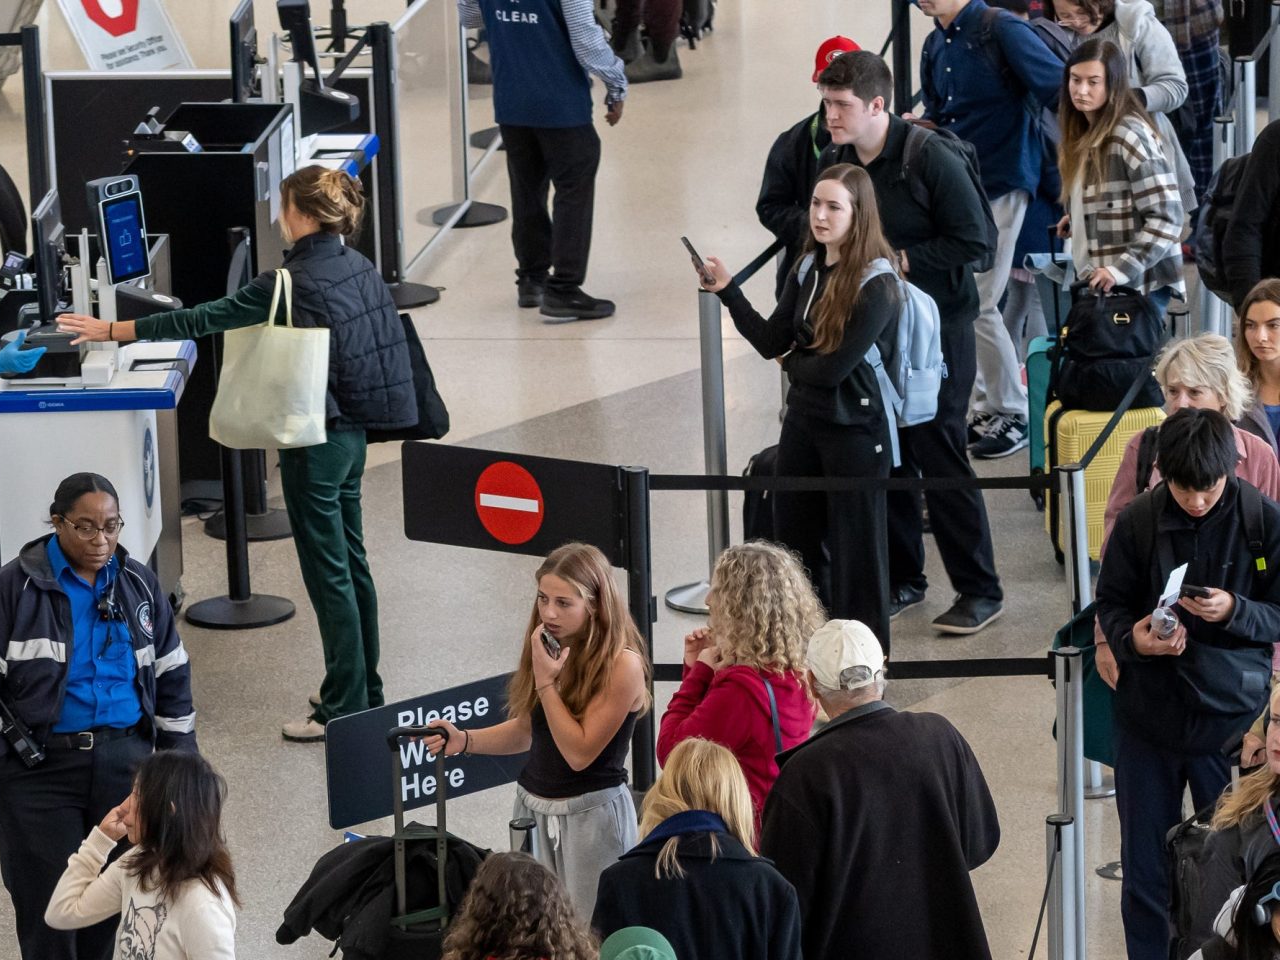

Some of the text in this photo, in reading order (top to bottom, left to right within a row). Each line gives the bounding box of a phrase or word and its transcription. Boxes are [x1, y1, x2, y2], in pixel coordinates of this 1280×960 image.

[495, 9, 539, 24] CLEAR
[397, 697, 490, 727] Please
[401, 768, 465, 802] Hee
